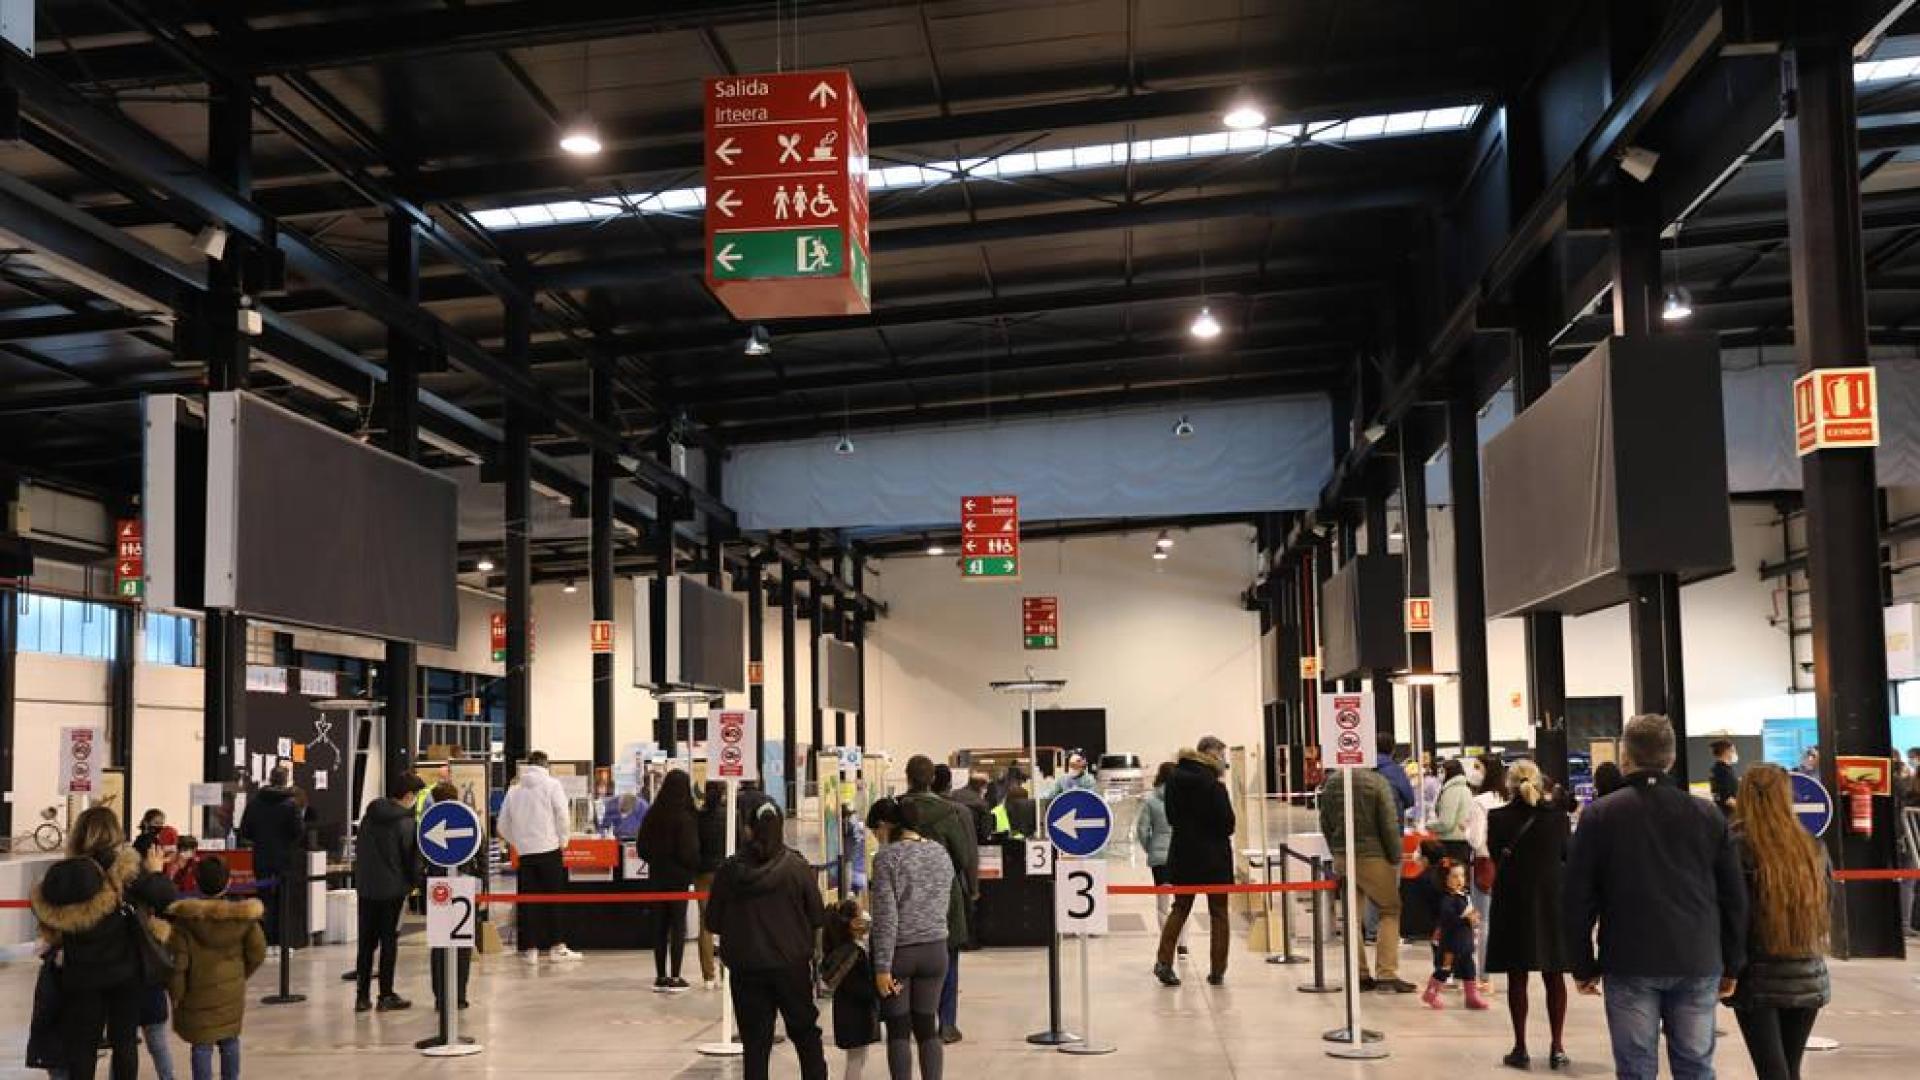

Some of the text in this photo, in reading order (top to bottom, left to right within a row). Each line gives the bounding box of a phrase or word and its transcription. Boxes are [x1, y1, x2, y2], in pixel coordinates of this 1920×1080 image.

[715, 79, 769, 98] Salida
[715, 107, 769, 123] Irteera
[1032, 845, 1046, 868] 3
[1068, 870, 1095, 919] 3
[451, 896, 472, 939] 2
